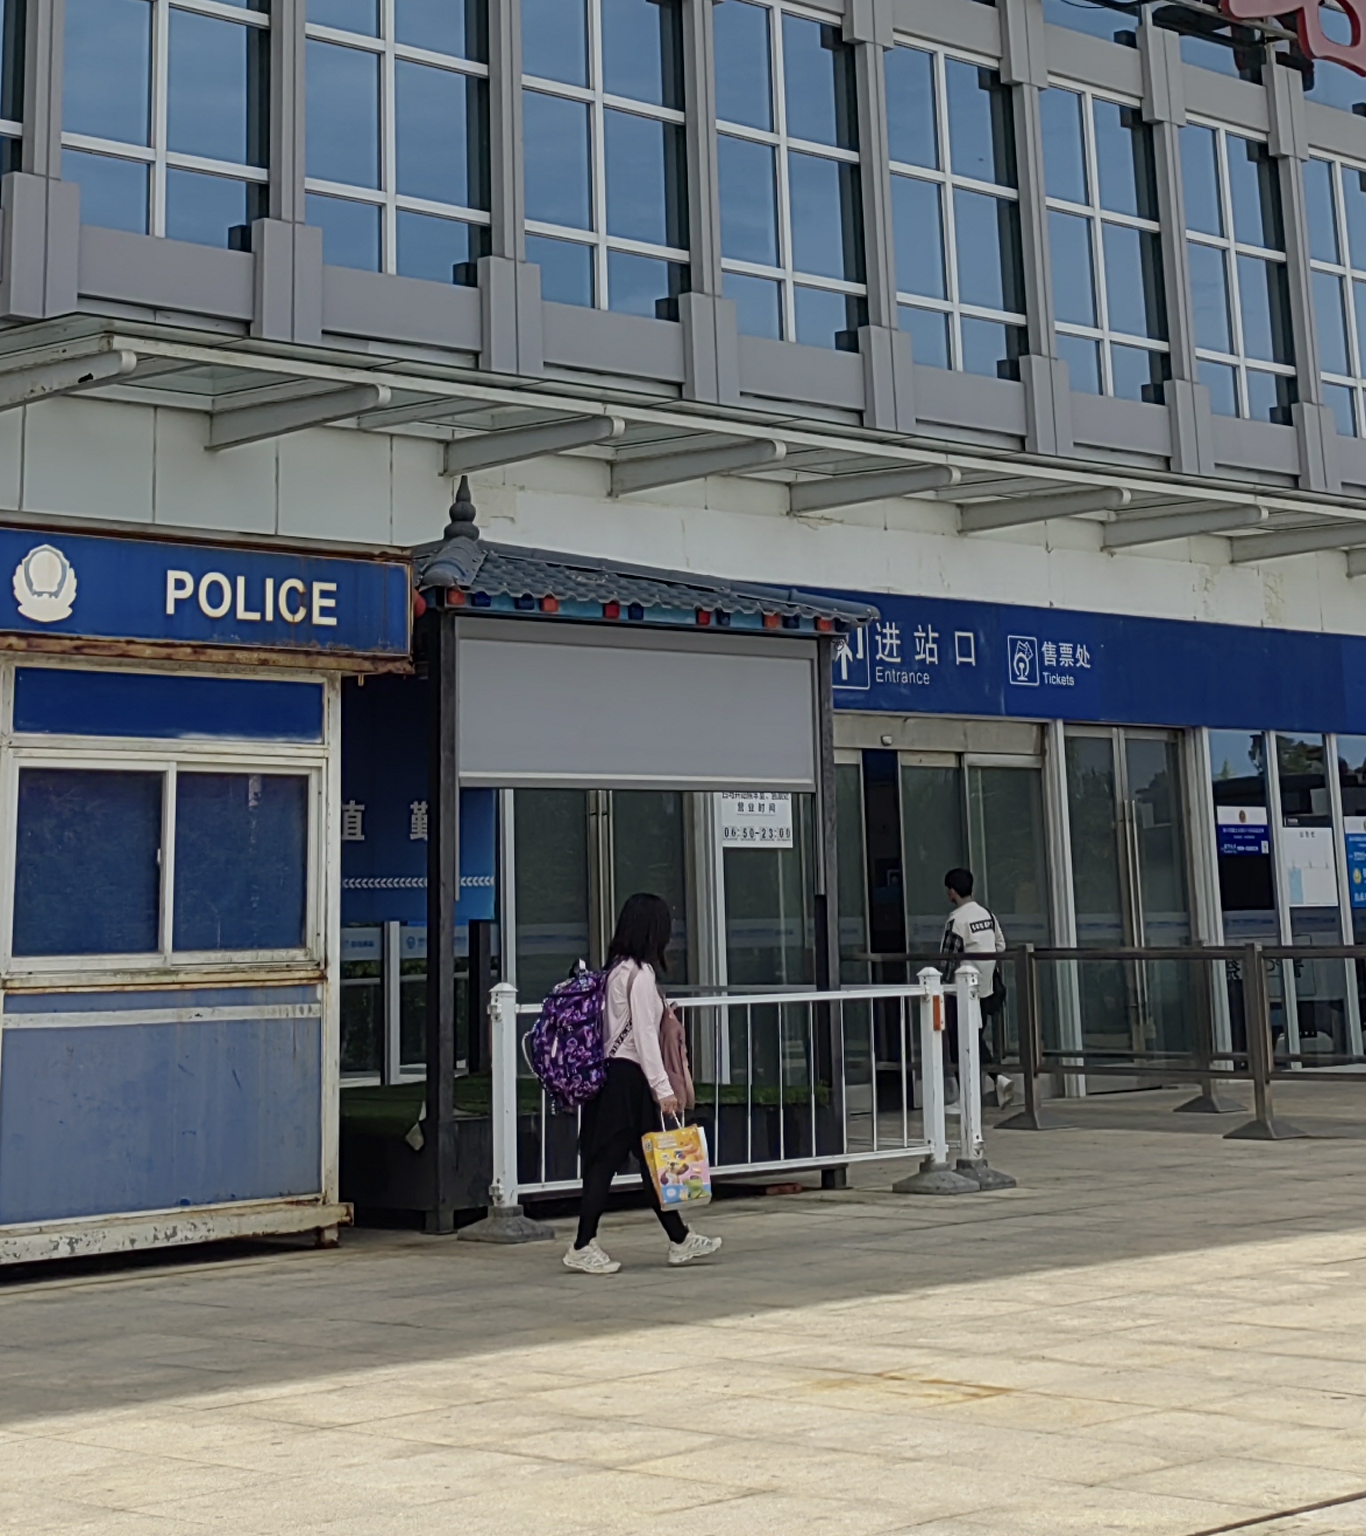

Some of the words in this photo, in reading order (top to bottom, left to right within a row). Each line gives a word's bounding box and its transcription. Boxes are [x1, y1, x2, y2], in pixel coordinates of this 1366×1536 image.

[165, 569, 339, 626] POLICE
[875, 622, 976, 666] 进站口
[1041, 640, 1091, 669] 售票处
[875, 667, 930, 685] Entrance
[1043, 672, 1075, 686] Tickets
